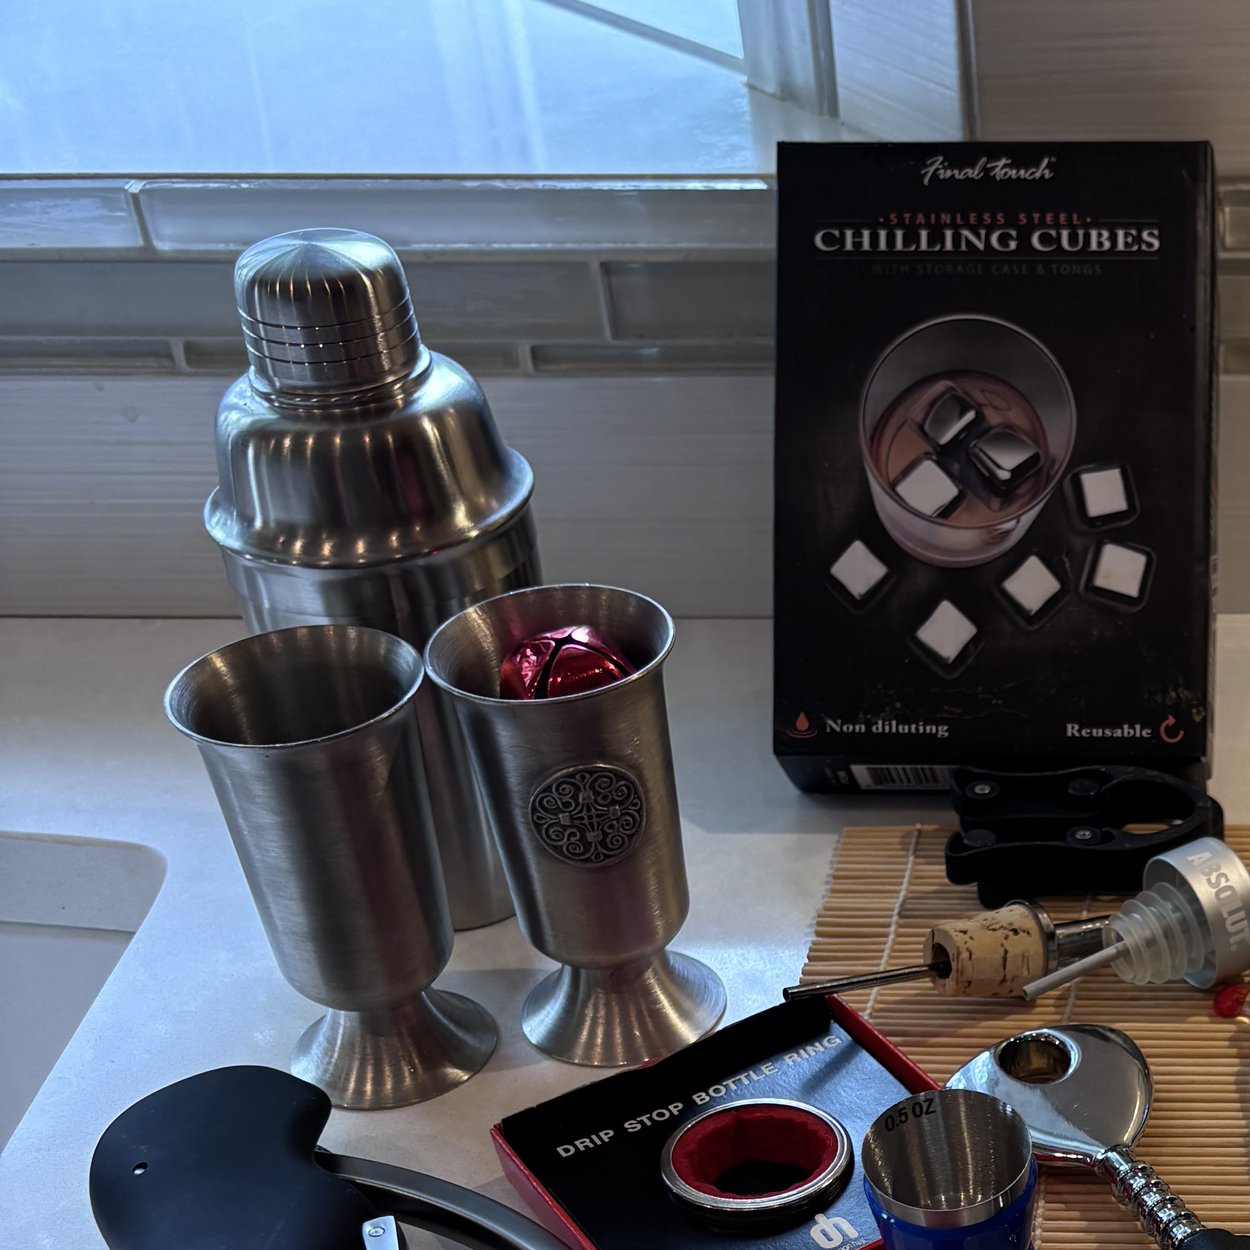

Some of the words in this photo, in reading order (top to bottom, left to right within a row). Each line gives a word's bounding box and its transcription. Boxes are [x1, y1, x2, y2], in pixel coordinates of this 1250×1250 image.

[920, 156, 987, 186] Final
[888, 213, 1006, 225] STAINLESS
[1018, 213, 1082, 225] STEEL
[813, 228, 1019, 252] CHILLING
[1030, 228, 1161, 252] CUBES
[991, 264, 1028, 276] CASE
[1051, 264, 1102, 276] TONGS
[825, 719, 866, 734] Non
[871, 720, 950, 738] diluting
[1065, 723, 1152, 738] Reusable
[556, 1129, 615, 1159] DRIP
[624, 1101, 684, 1133] STOP
[692, 1060, 778, 1105] BOTTLE
[783, 1033, 843, 1066] RING
[885, 1107, 908, 1132] 0.5
[912, 1098, 936, 1118] OZ
